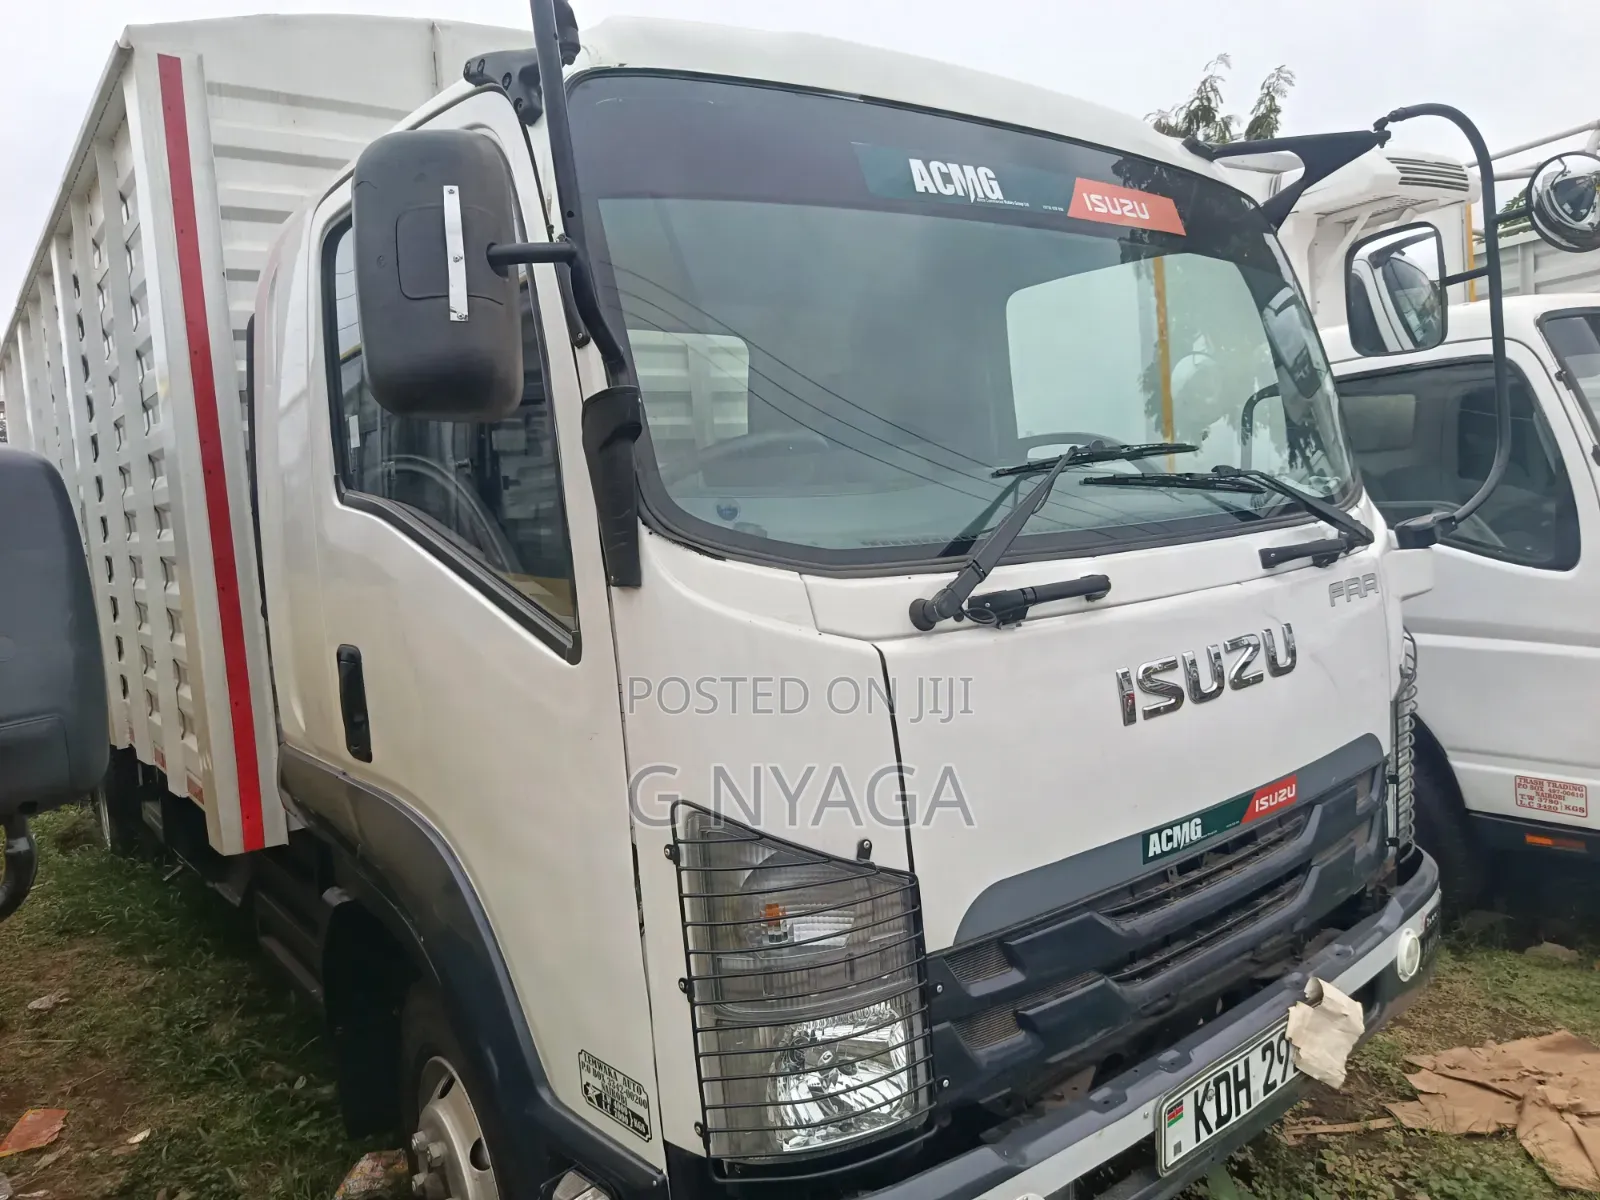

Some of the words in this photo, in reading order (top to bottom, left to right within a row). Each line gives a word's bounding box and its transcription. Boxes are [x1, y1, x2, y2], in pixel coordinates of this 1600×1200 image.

[909, 158, 1004, 203] ACMG
[1083, 192, 1150, 220] ISUZU
[1116, 622, 1297, 727] ISUZU
[1255, 784, 1296, 813] ISUZU
[1535, 791, 1566, 801] NAIROBI
[1546, 781, 1584, 793] TRADING
[1564, 804, 1585, 813] KGS
[1148, 817, 1202, 858] ACMG
[592, 1067, 606, 1082] BOX
[622, 1076, 642, 1096] AUTO
[1193, 1055, 1252, 1144] KDH
[1261, 1031, 1300, 1097] 29
[601, 1080, 628, 1107] NAIROBI
